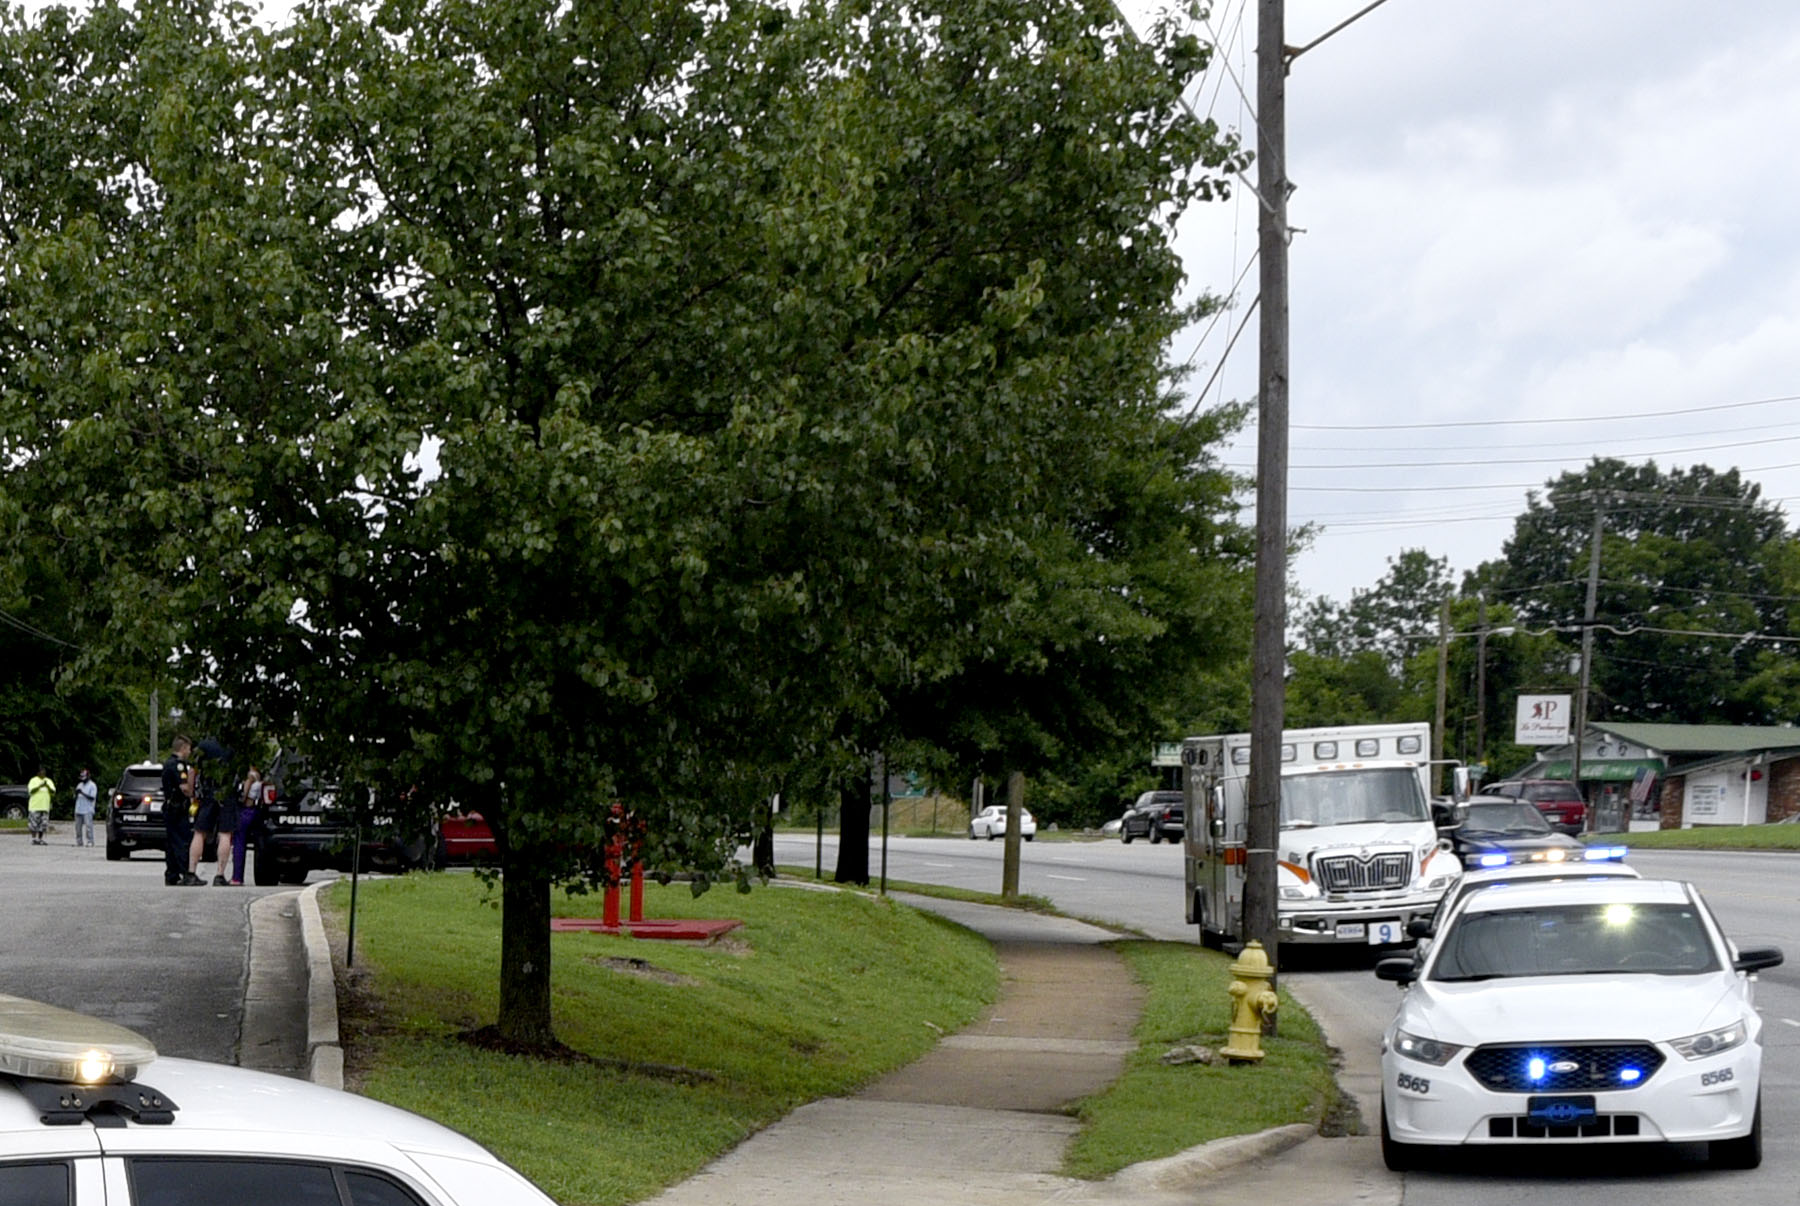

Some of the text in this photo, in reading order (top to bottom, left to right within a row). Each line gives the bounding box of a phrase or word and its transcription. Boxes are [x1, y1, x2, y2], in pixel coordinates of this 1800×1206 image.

[1379, 924, 1392, 943] 9
[1397, 1072, 1430, 1094] 8565
[1701, 1067, 1734, 1086] 8565
